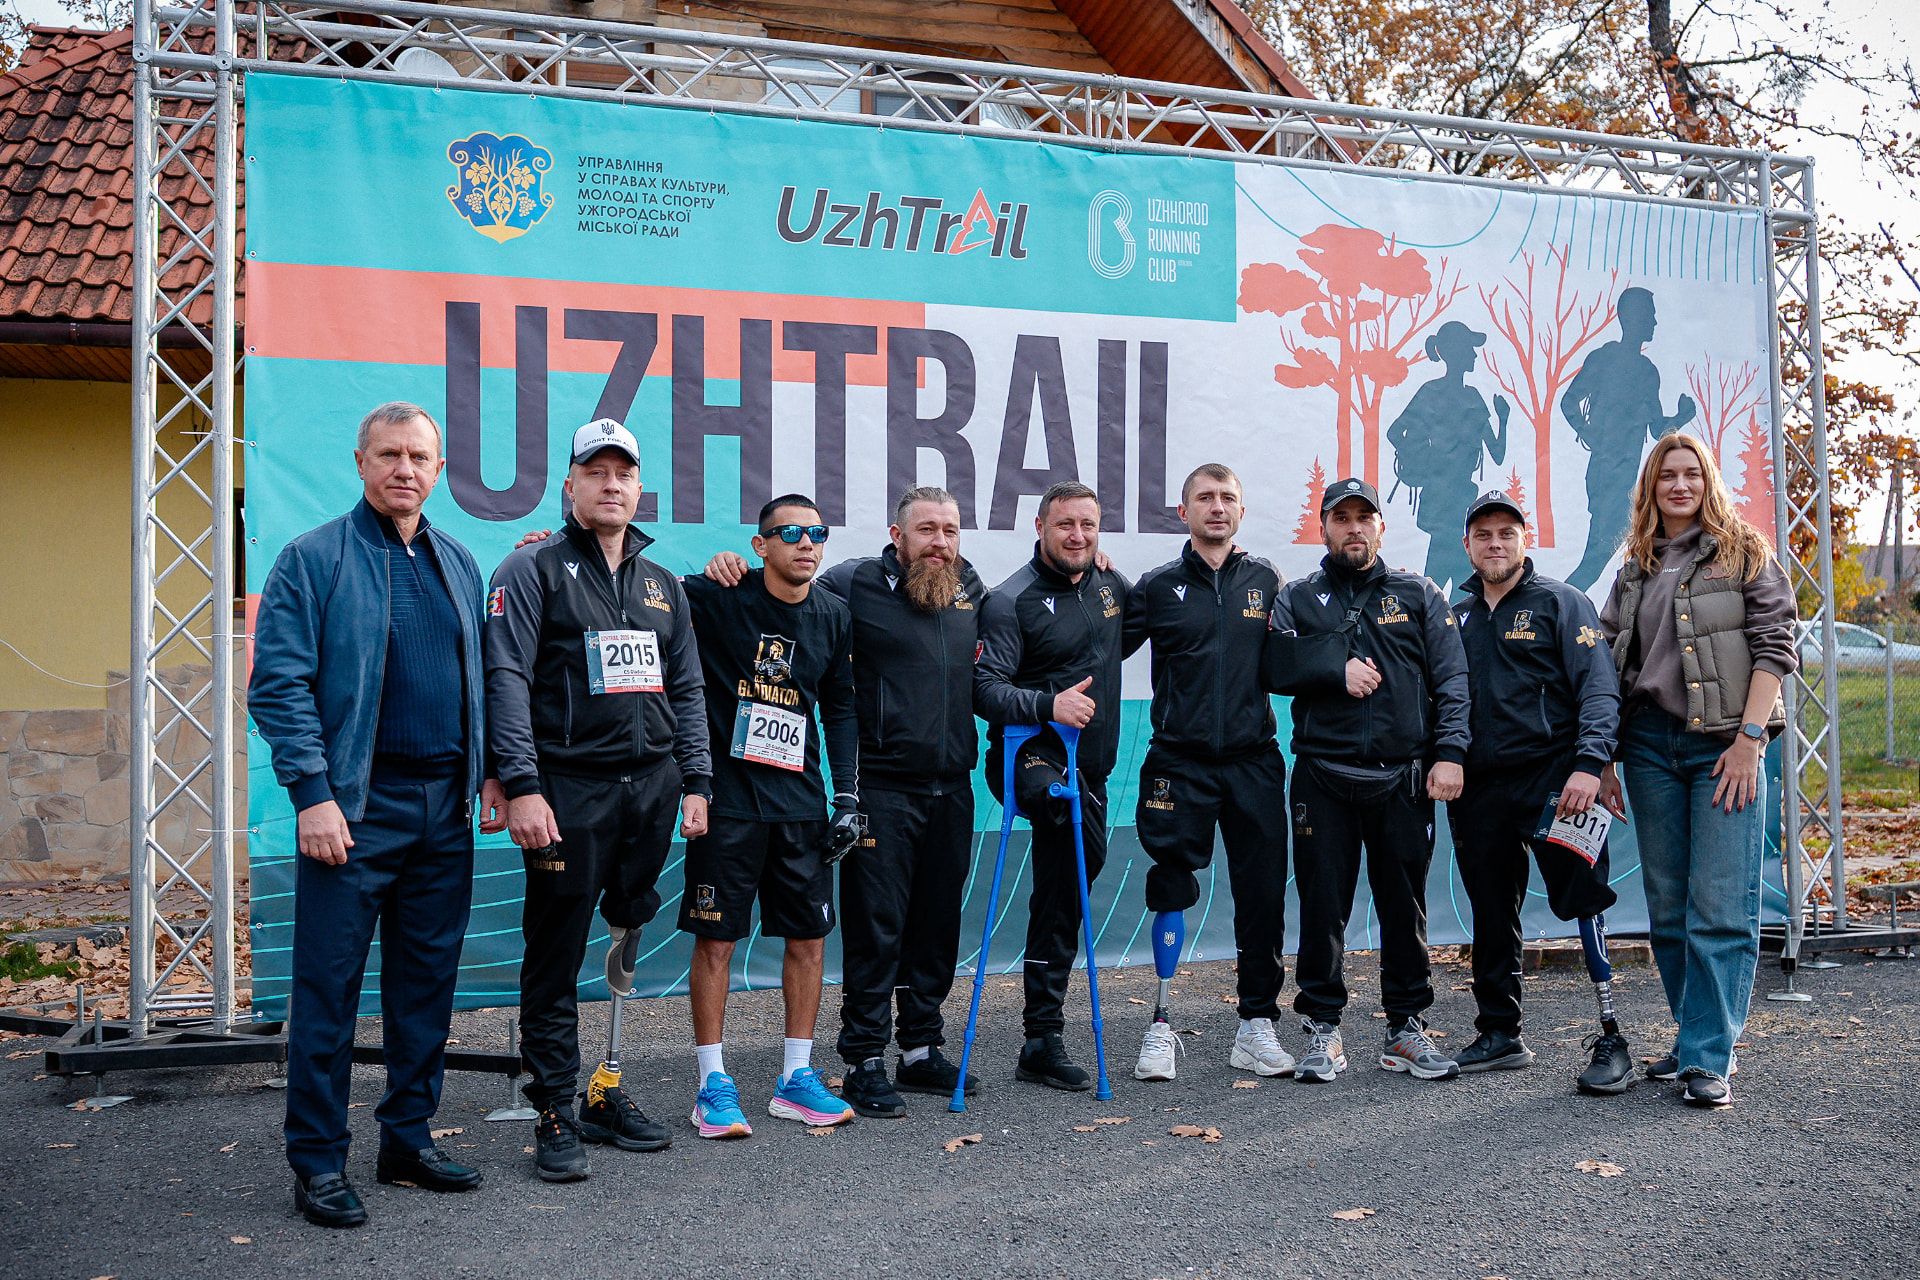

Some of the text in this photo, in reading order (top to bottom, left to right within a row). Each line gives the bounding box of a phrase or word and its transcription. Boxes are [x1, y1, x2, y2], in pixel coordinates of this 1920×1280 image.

[578, 156, 663, 173] УПРАВЛІННЯ
[578, 172, 730, 196] У СПРАВАХ КУЛЬТУРИ,
[577, 188, 715, 209] МОЛОДІ ТА СПОРТУ
[577, 204, 691, 223] УЖГОРОДСЬКОЇ
[1147, 198, 1209, 226] UZHHOROD
[577, 220, 679, 239] МІСЬКОЇ РАДИ
[1148, 227, 1200, 255] RUNNING
[1148, 257, 1177, 283] CLUB
[445, 300, 1191, 535] UZHTRAIL
[583, 437, 605, 448] SPORT
[1377, 613, 1409, 625] GLADIATOR
[1504, 631, 1536, 640] GLADIATOR
[605, 643, 655, 667] 2015
[737, 679, 800, 707] GLADIATOR
[753, 716, 800, 747] 2006
